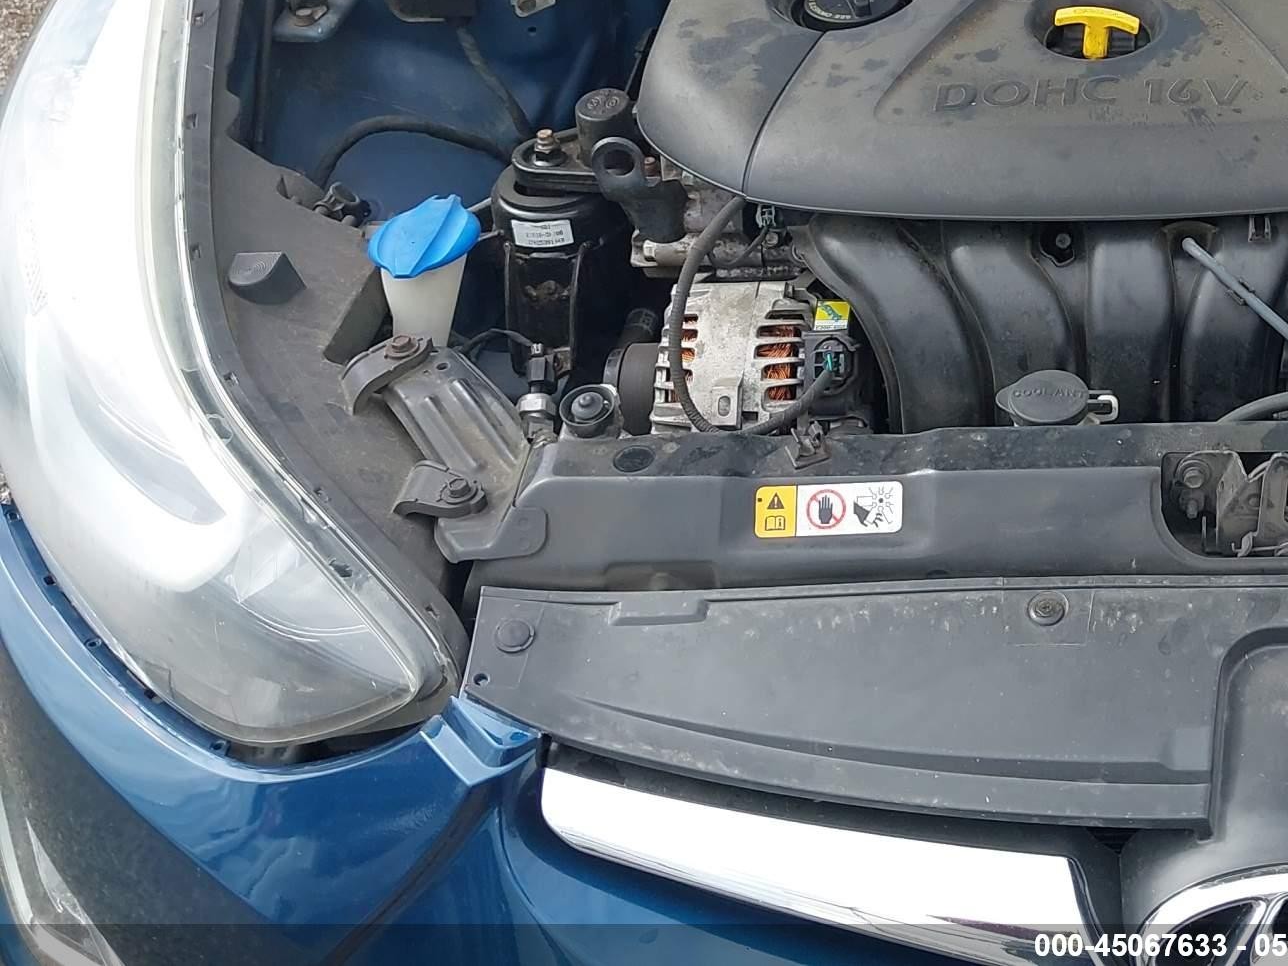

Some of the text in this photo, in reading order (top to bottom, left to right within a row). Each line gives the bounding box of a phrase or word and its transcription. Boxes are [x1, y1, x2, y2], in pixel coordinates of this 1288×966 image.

[933, 75, 1247, 113] DOHC 16V
[1012, 386, 1088, 399] COOLANT
